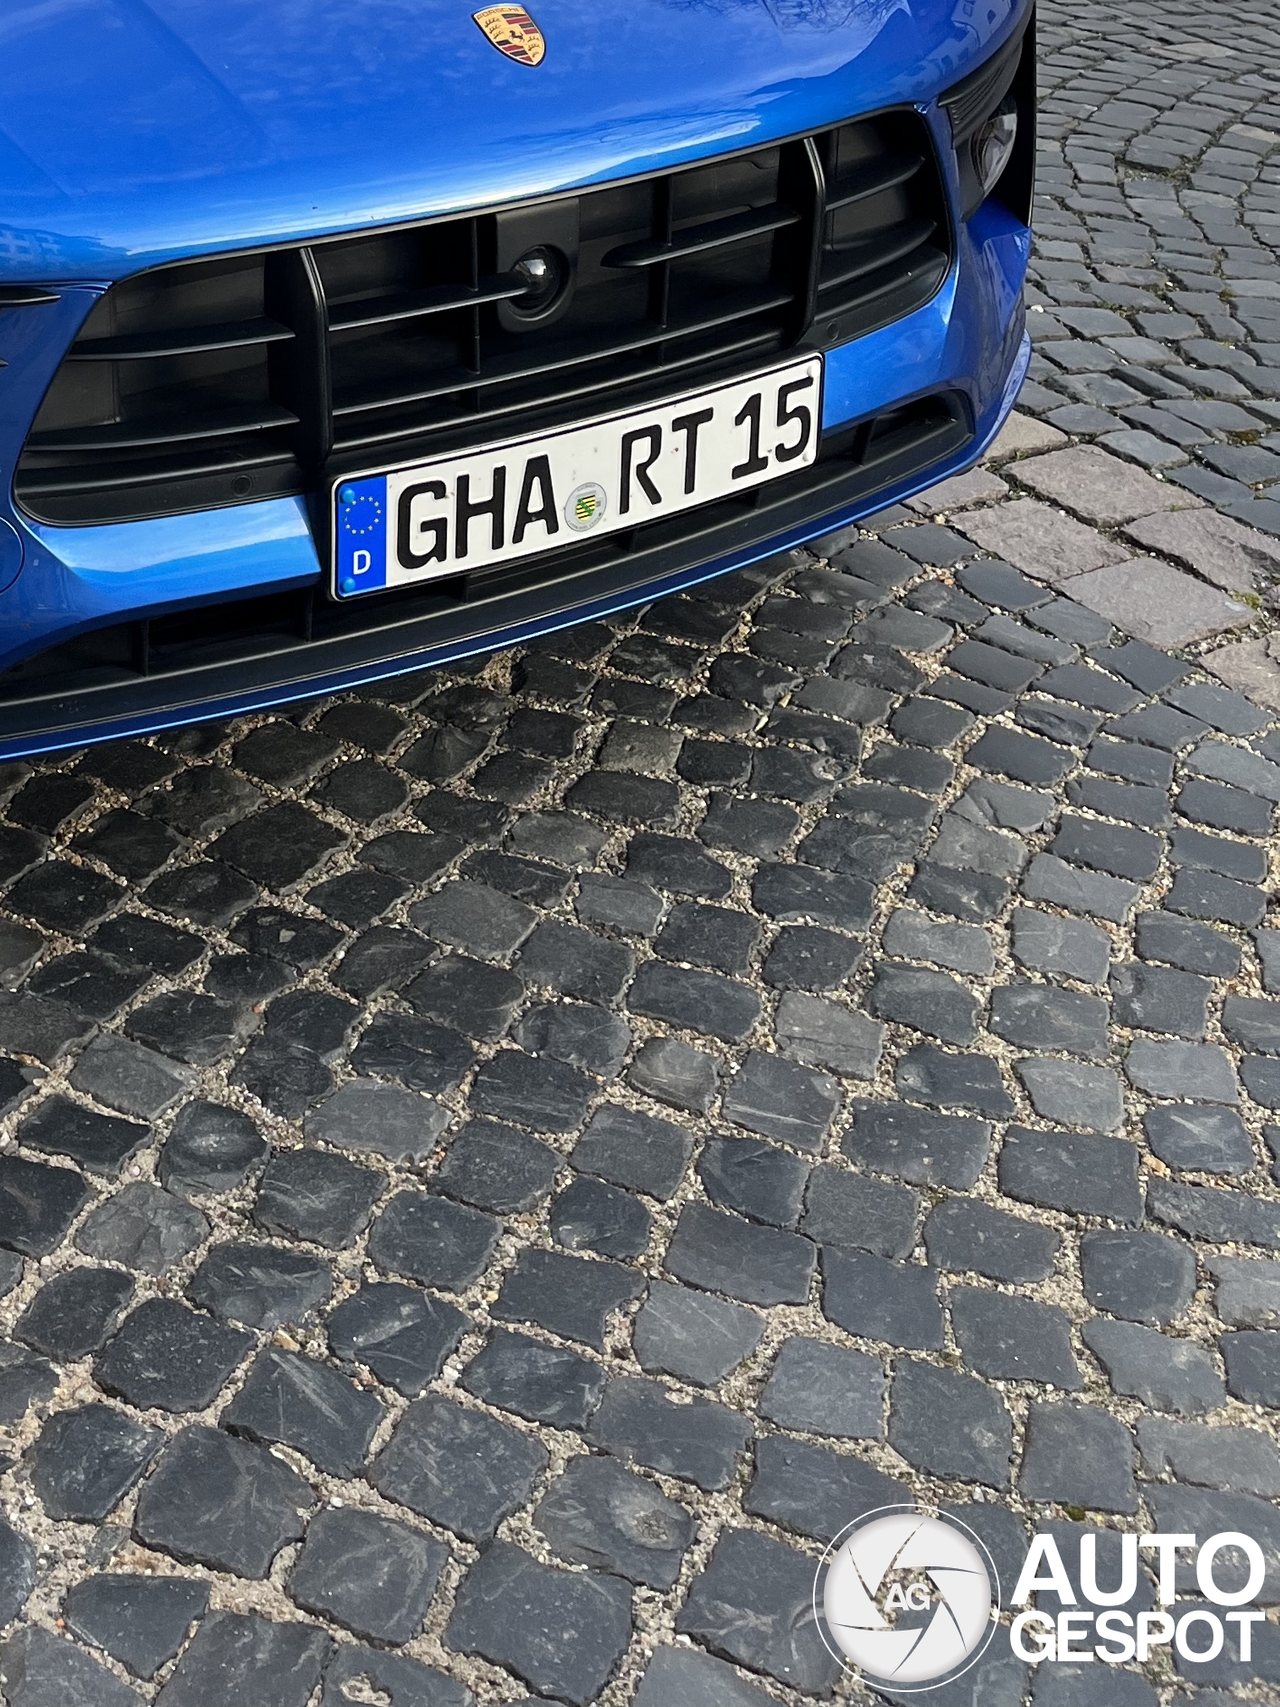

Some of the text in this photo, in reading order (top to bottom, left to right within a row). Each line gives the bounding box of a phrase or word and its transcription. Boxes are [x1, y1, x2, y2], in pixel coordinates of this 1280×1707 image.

[396, 376, 815, 570] GHA RT 15
[353, 549, 371, 575] D
